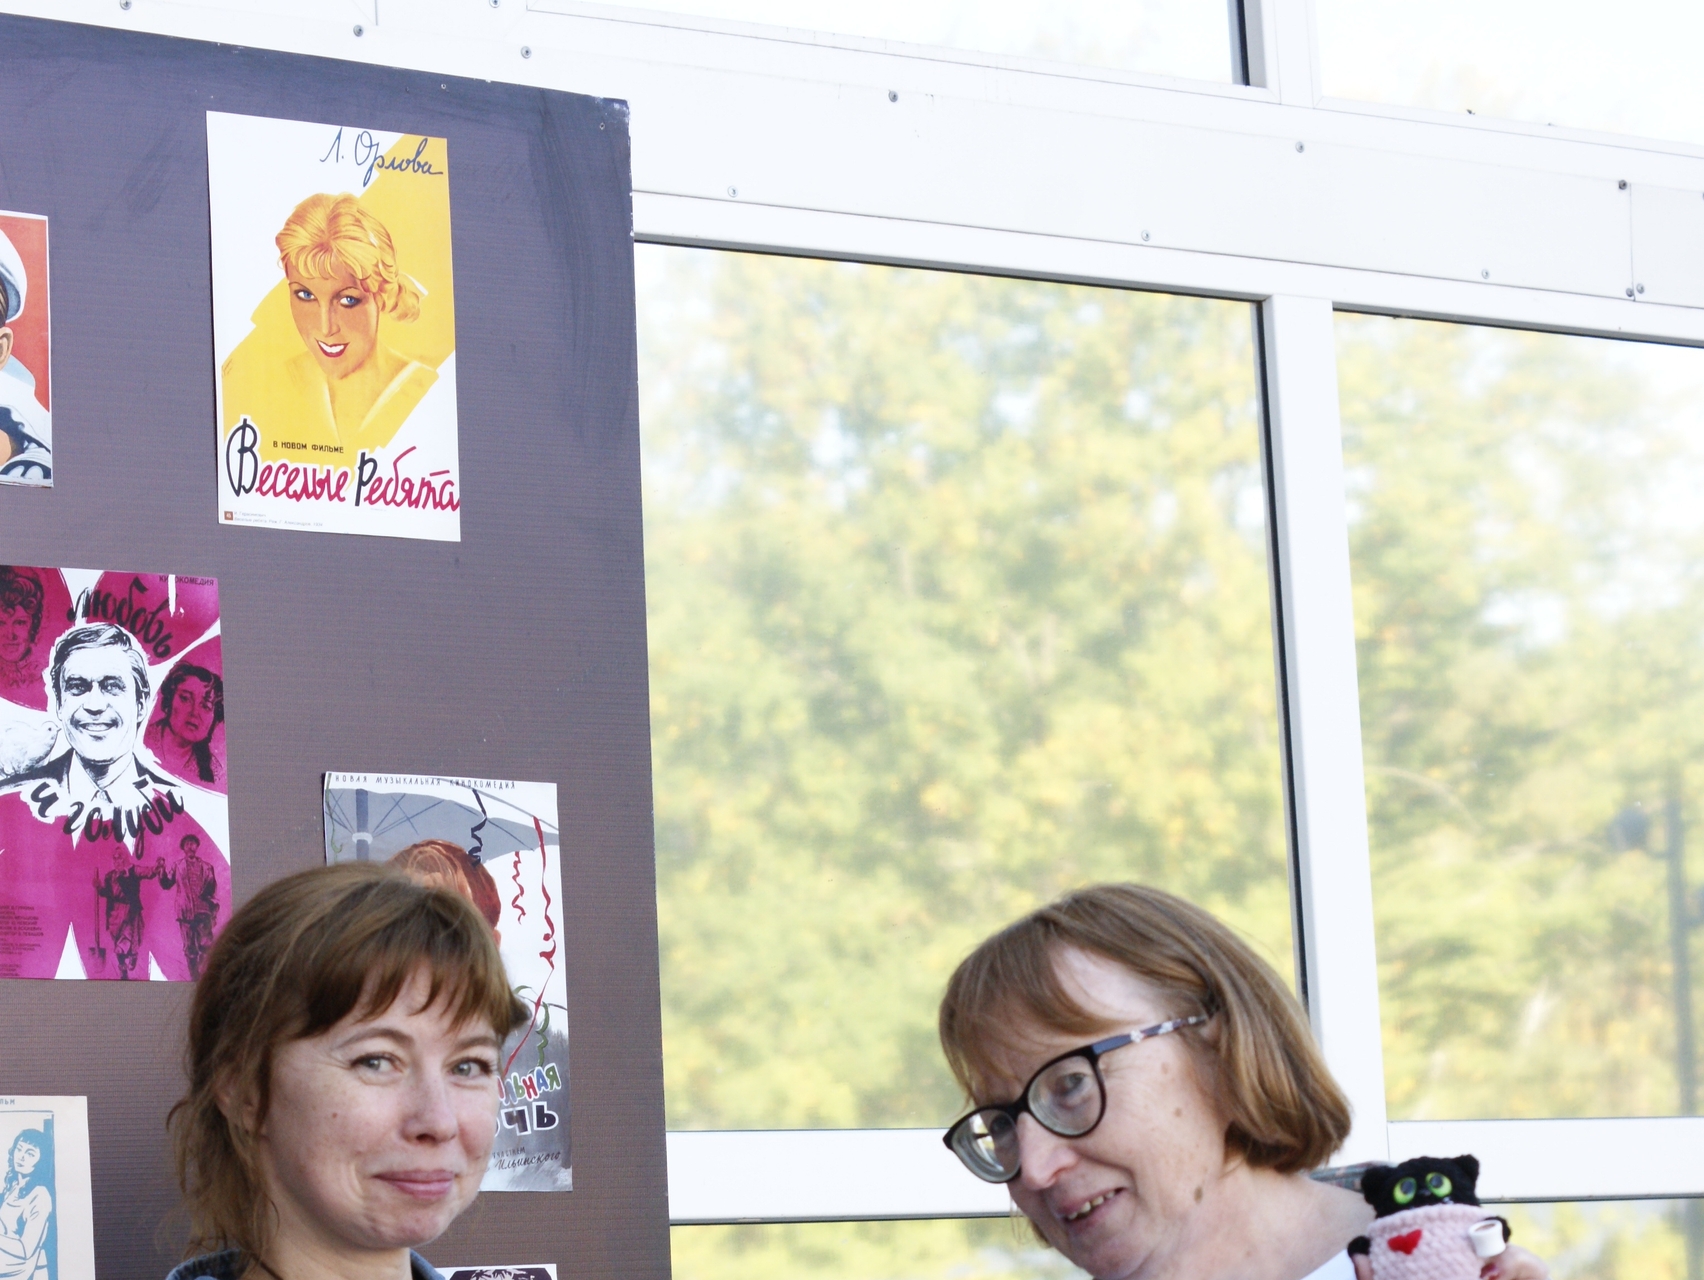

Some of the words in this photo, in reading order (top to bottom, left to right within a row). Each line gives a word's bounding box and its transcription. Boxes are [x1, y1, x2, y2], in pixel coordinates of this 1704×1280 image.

[355, 130, 443, 187] Орлова
[272, 440, 278, 448] В
[281, 441, 307, 450] НОВОМ
[311, 444, 344, 453] ФИЛЬМЕ
[226, 418, 348, 502] Веселые
[354, 446, 460, 512] Ребята
[159, 575, 214, 586] КИОКОМЕДИЯ
[335, 775, 367, 783] НОВАЯ
[375, 776, 441, 786] МУЗЫКАЛЬНАЯ
[449, 779, 516, 790] КИНОКОМЕДИЯ
[495, 1101, 559, 1136] ЧЬ
